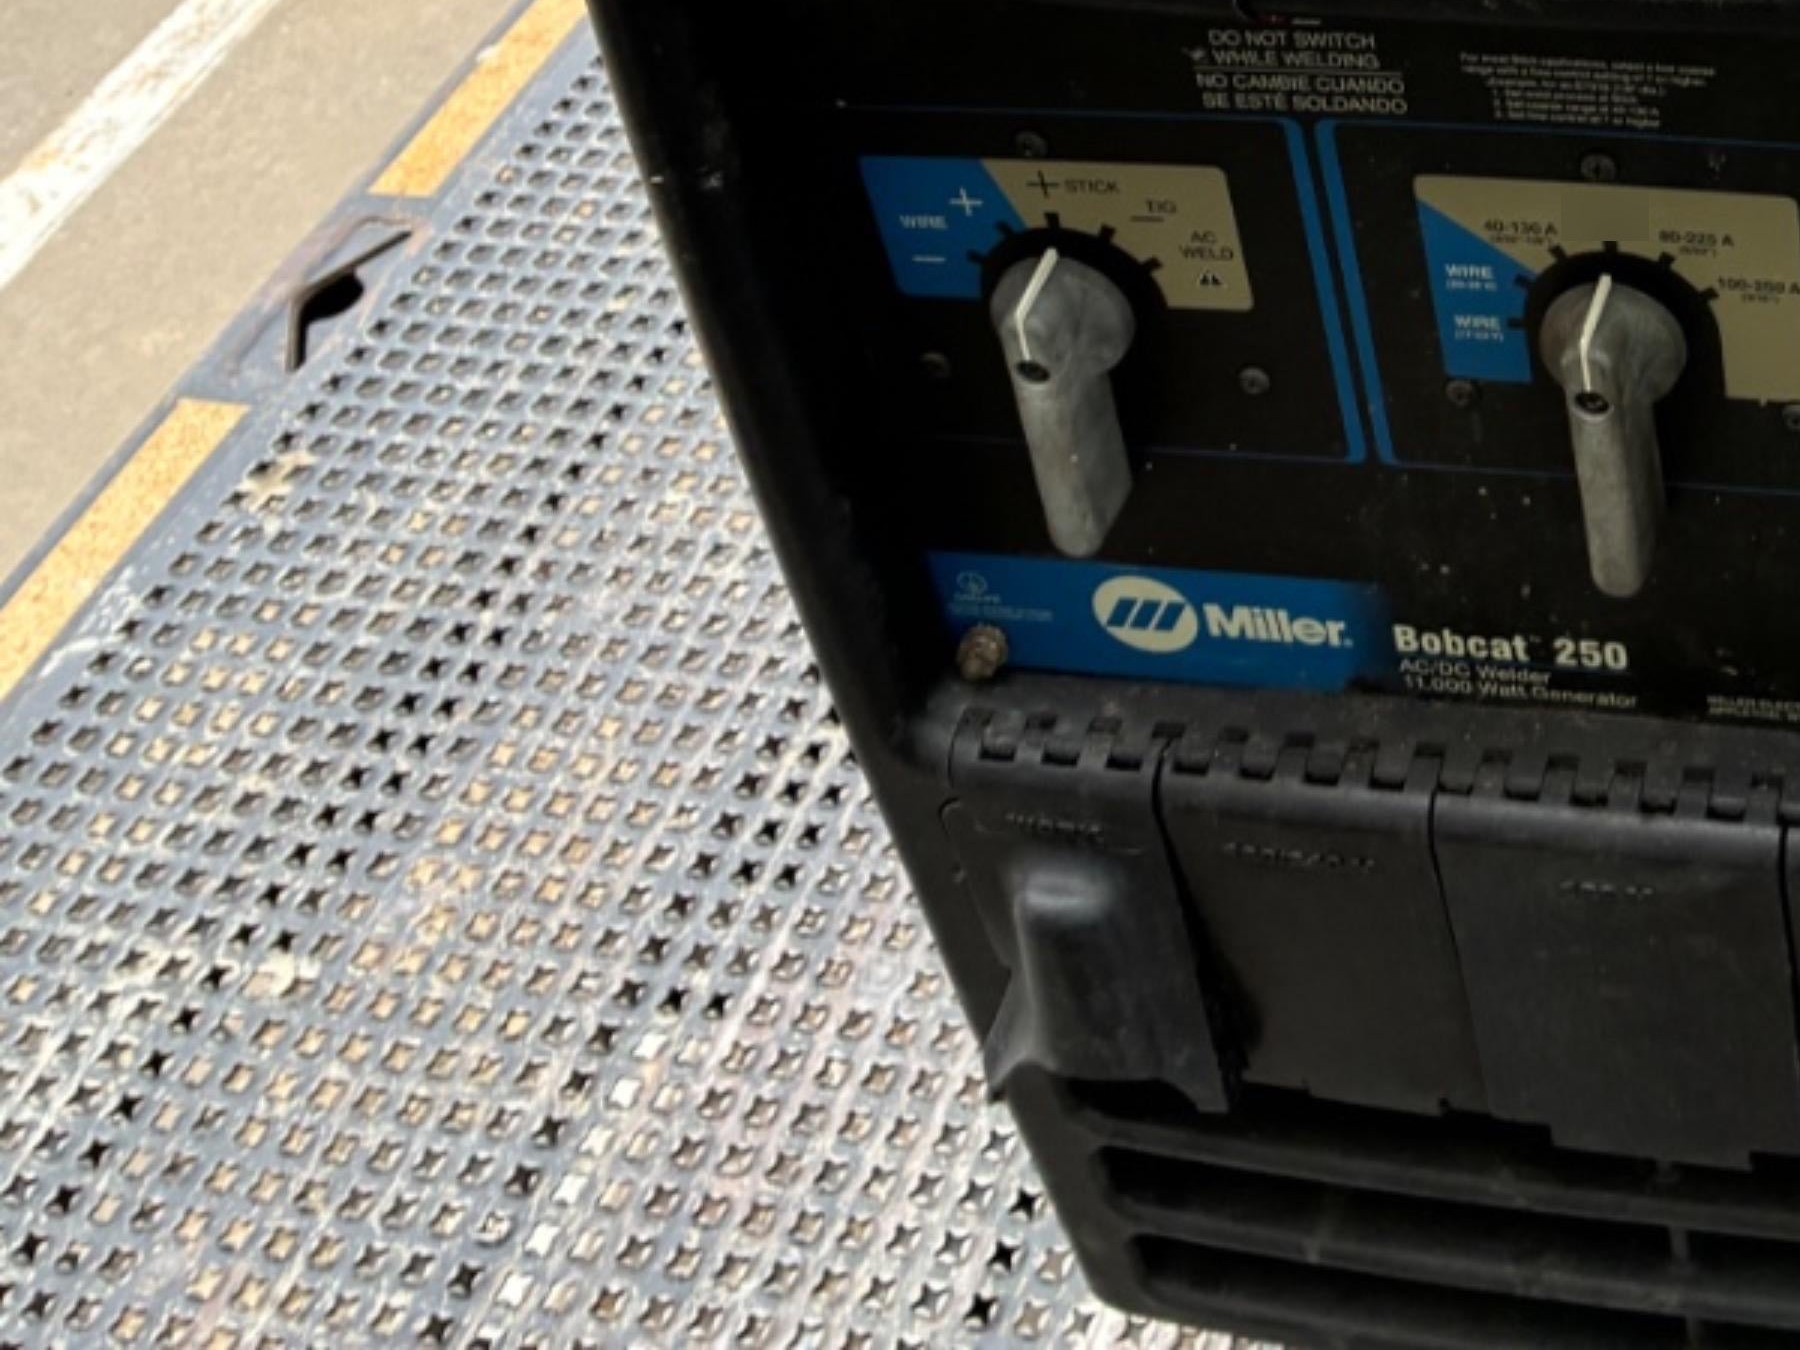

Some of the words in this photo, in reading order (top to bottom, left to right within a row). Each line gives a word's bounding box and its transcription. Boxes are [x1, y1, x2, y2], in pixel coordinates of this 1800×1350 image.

[1207, 29, 1242, 47] DO
[1244, 29, 1287, 47] NOT
[1292, 30, 1376, 50] SWITCH
[1211, 49, 1279, 67] WHILE
[1195, 73, 1229, 89] NO
[1315, 76, 1406, 95] CUANDO
[1292, 95, 1409, 116] SOLDANDO
[1063, 179, 1122, 196] STICK
[1145, 199, 1177, 215] TIG
[900, 215, 949, 231] WIRE
[1544, 221, 1559, 237] A
[1190, 229, 1217, 245] AC
[1721, 235, 1736, 249] A
[1179, 246, 1235, 261] WELD
[1444, 263, 1496, 280] WIRE
[1453, 314, 1501, 331] WIRE
[1553, 638, 1629, 671] 250
[1399, 659, 1472, 680] AC/DC
[1475, 662, 1552, 686] Welder
[1476, 680, 1528, 699] Watt
[1531, 685, 1638, 710] Generator
